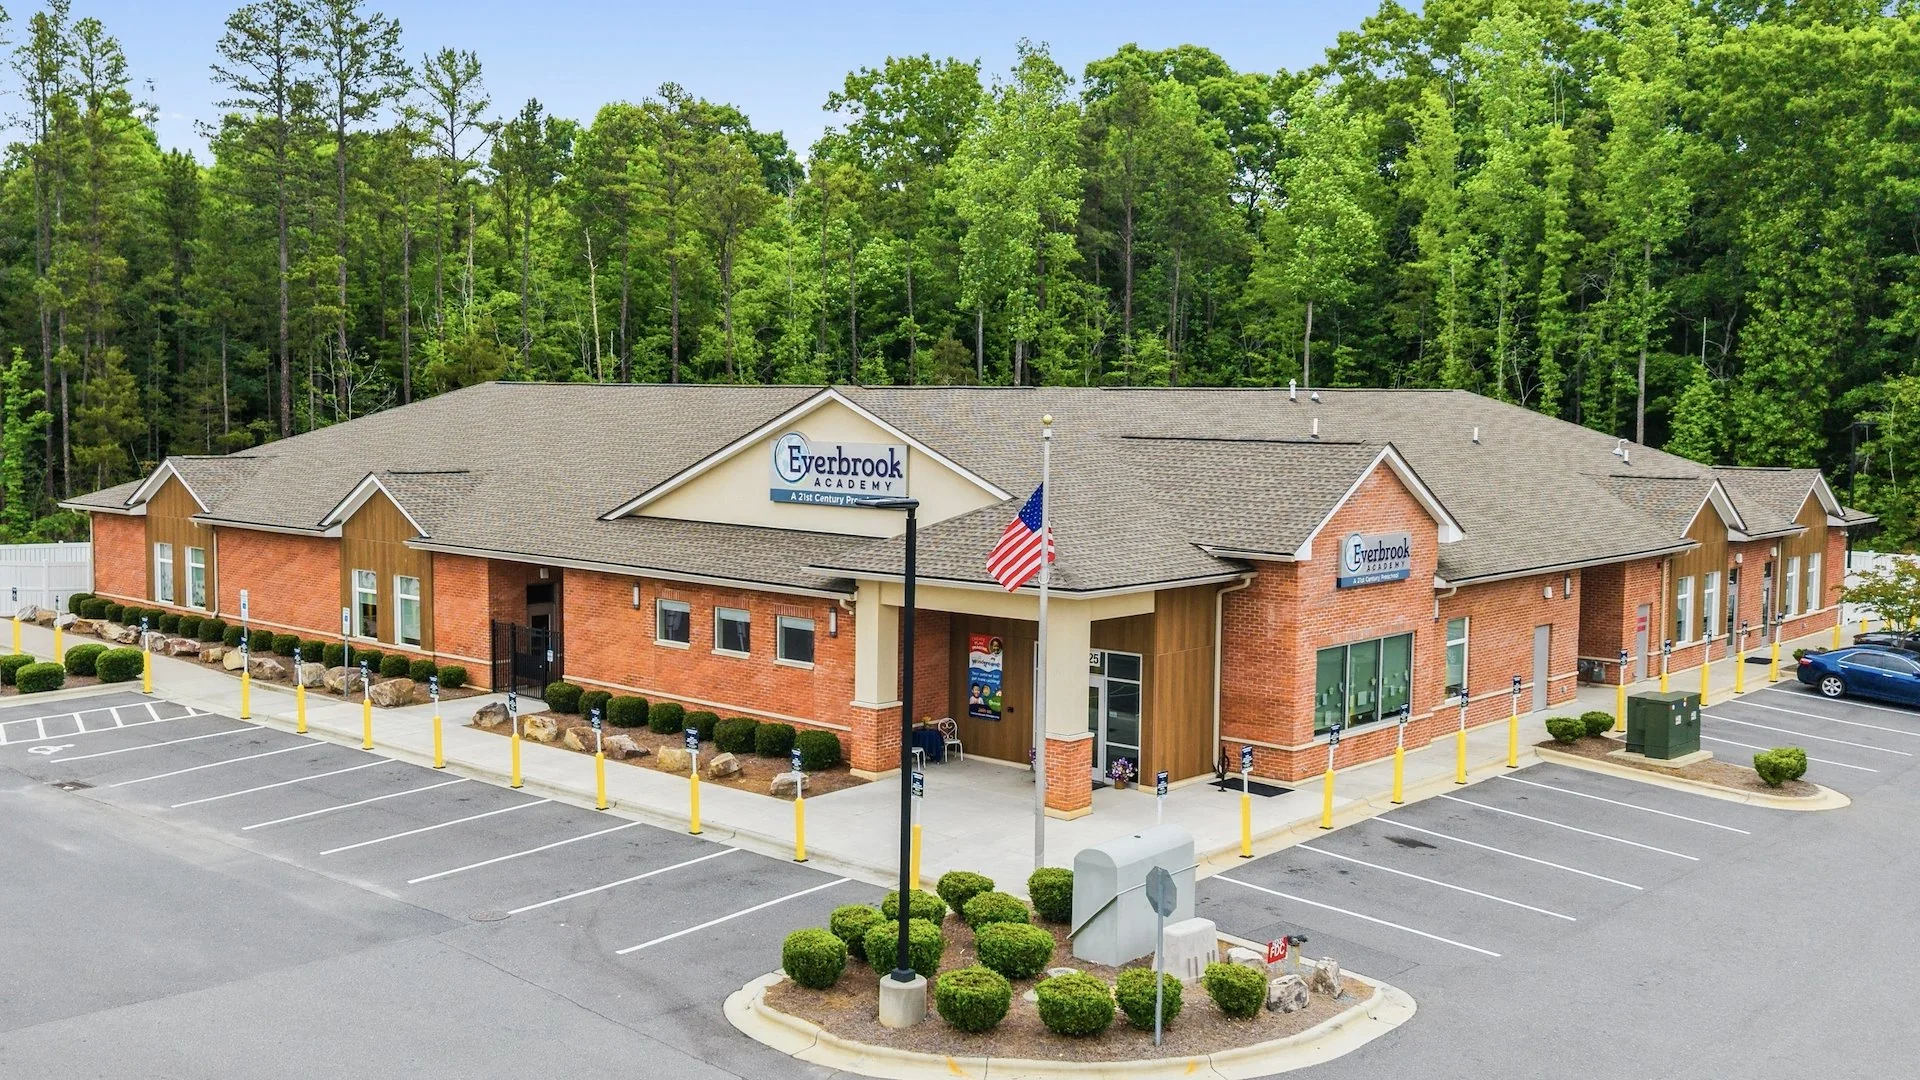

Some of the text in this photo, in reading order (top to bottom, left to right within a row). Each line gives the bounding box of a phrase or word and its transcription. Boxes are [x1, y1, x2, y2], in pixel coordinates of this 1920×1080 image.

[788, 445, 903, 478] Everbrook
[814, 477, 892, 491] ACADEMY
[790, 491, 797, 500] A
[798, 492, 813, 502] 21st
[814, 493, 844, 505] Century
[1354, 537, 1410, 564] Everbrook
[1366, 561, 1405, 572] ACADEMY
[1270, 943, 1285, 958] FDC
